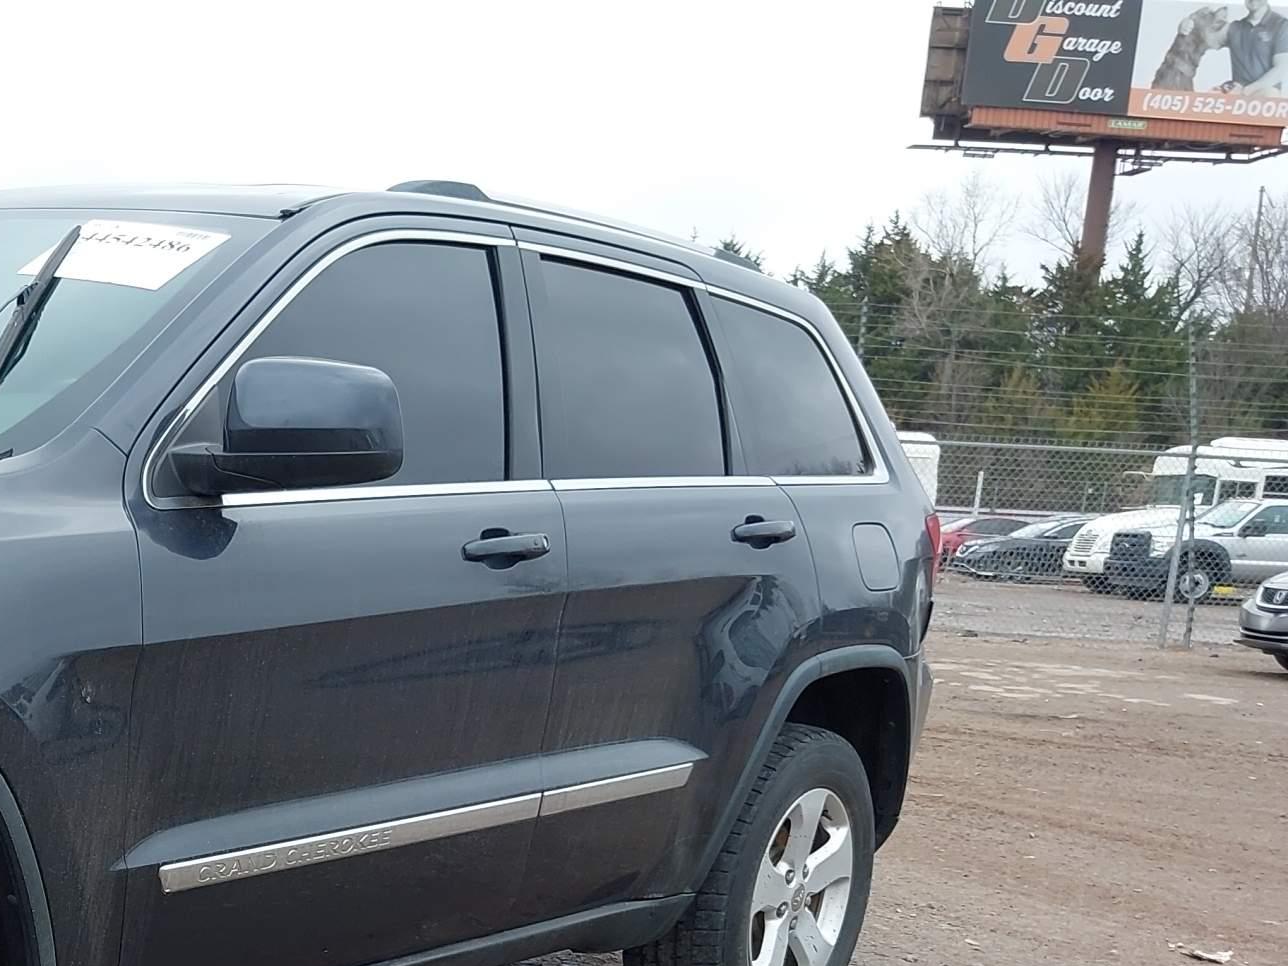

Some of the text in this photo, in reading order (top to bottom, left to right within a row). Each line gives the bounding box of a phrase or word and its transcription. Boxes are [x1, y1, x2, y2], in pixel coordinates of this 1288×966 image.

[1003, 15, 1122, 64] Garage
[1022, 56, 1115, 104] Door
[1143, 93, 1288, 118] (405) 525-DOOR
[81, 231, 191, 252] 44542486
[197, 830, 393, 883] GRAND CHEROKEE
